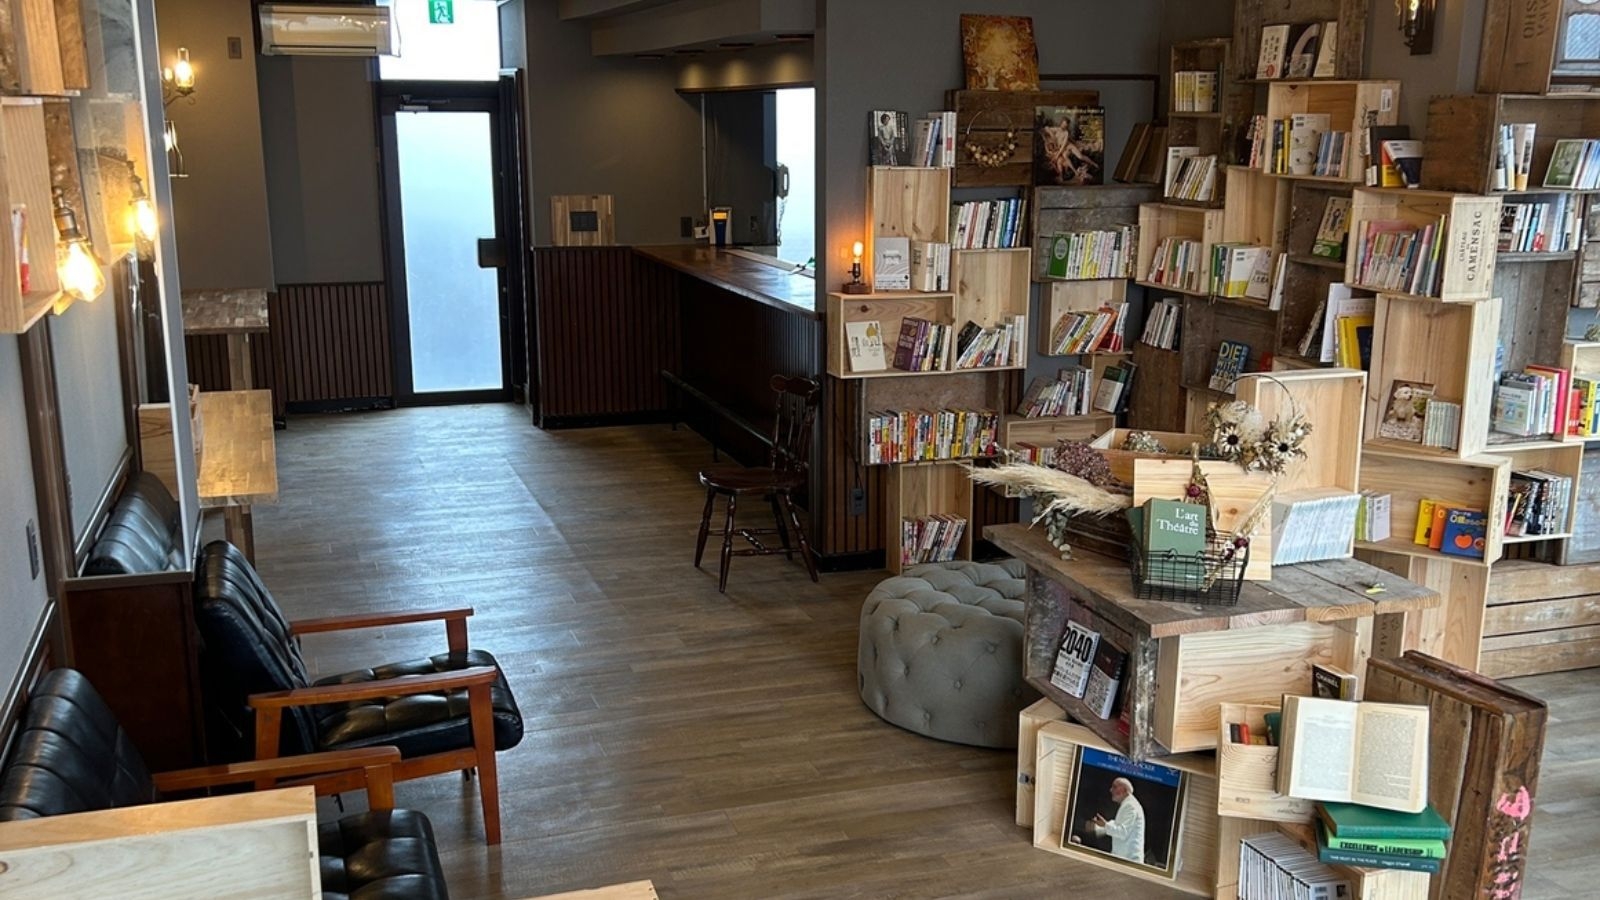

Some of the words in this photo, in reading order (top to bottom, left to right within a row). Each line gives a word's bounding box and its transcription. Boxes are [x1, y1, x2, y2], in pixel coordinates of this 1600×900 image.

[1467, 211, 1482, 282] CAMENSAC
[1219, 341, 1243, 361] DIE
[1216, 359, 1237, 372] WITH
[1156, 518, 1199, 535] Théâtre
[1060, 626, 1093, 663] 2040
[1315, 671, 1339, 689] CHANEL
